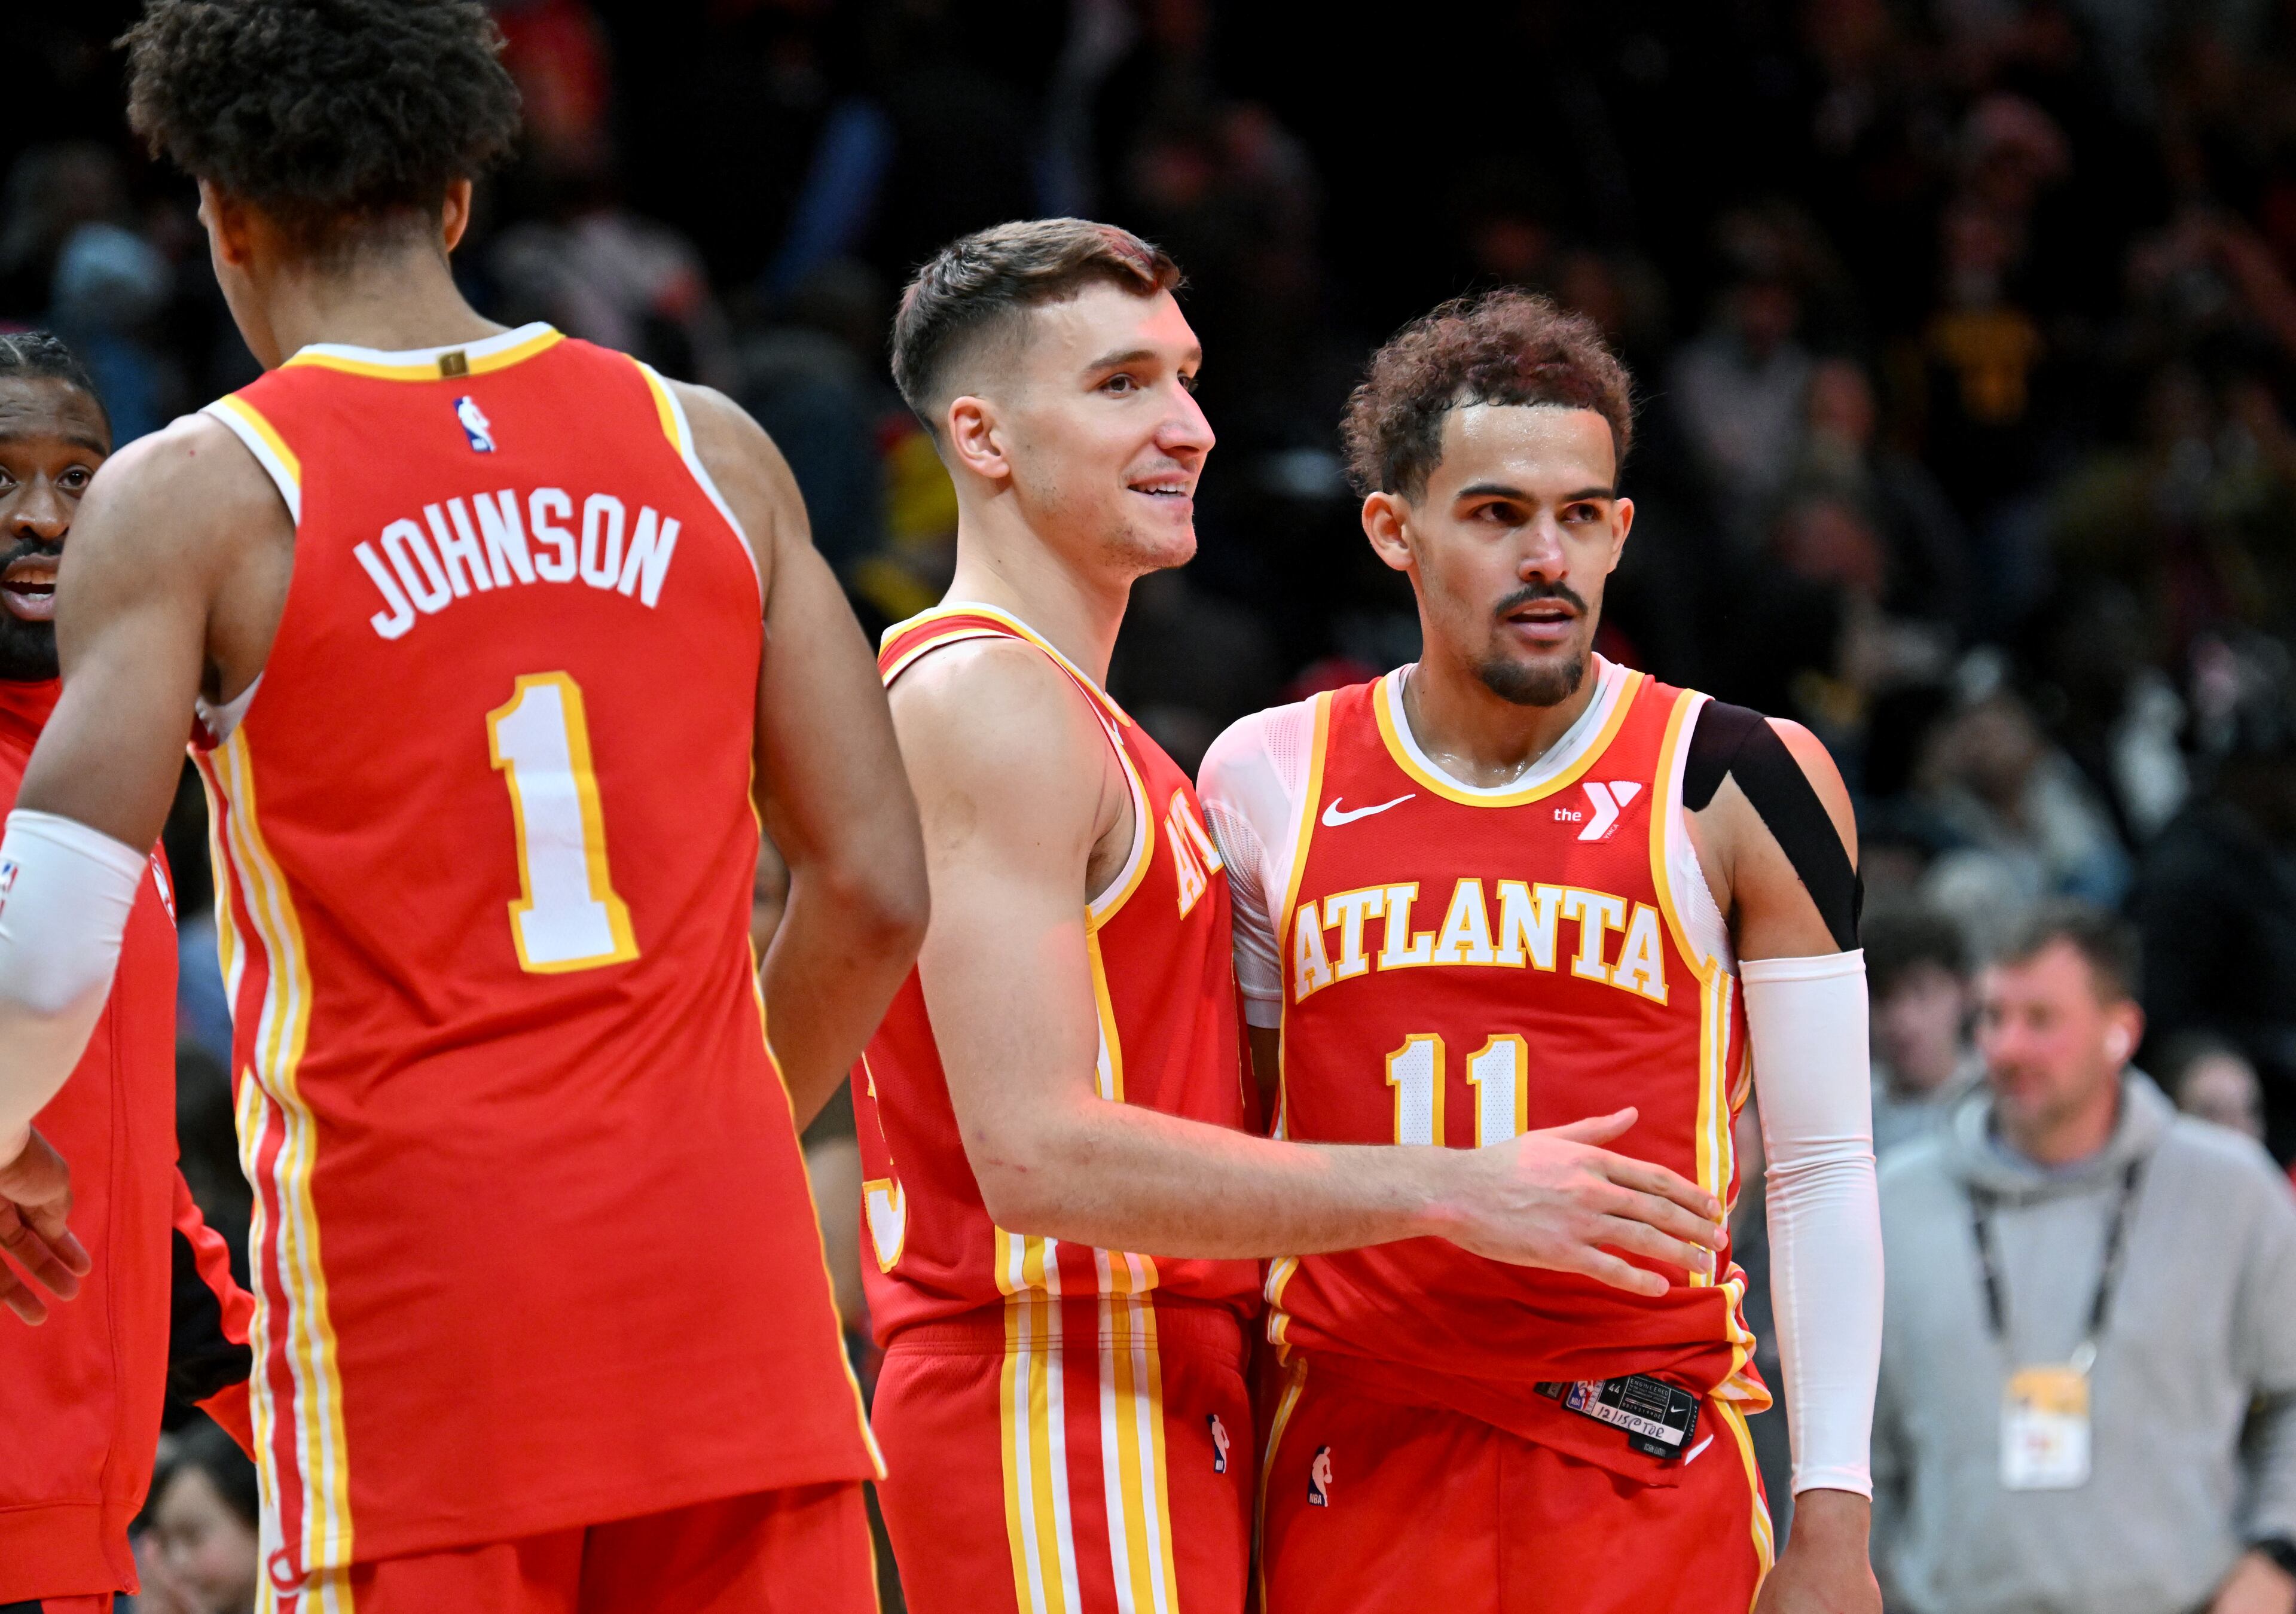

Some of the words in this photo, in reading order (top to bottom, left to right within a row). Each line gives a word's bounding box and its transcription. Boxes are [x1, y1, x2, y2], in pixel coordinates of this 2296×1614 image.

[352, 487, 681, 640] JOHNSON
[486, 670, 641, 974] 1
[1555, 808, 1581, 821] the
[1604, 824, 1620, 840] YMCA
[1294, 878, 1669, 1006] ATLANTA
[1385, 1033, 1528, 1149] 11
[1608, 1383, 1621, 1395] 44
[1630, 1378, 1669, 1397] ENGINEERED
[1570, 1396, 1581, 1406] NBA
[1309, 1493, 1322, 1505] NBA
